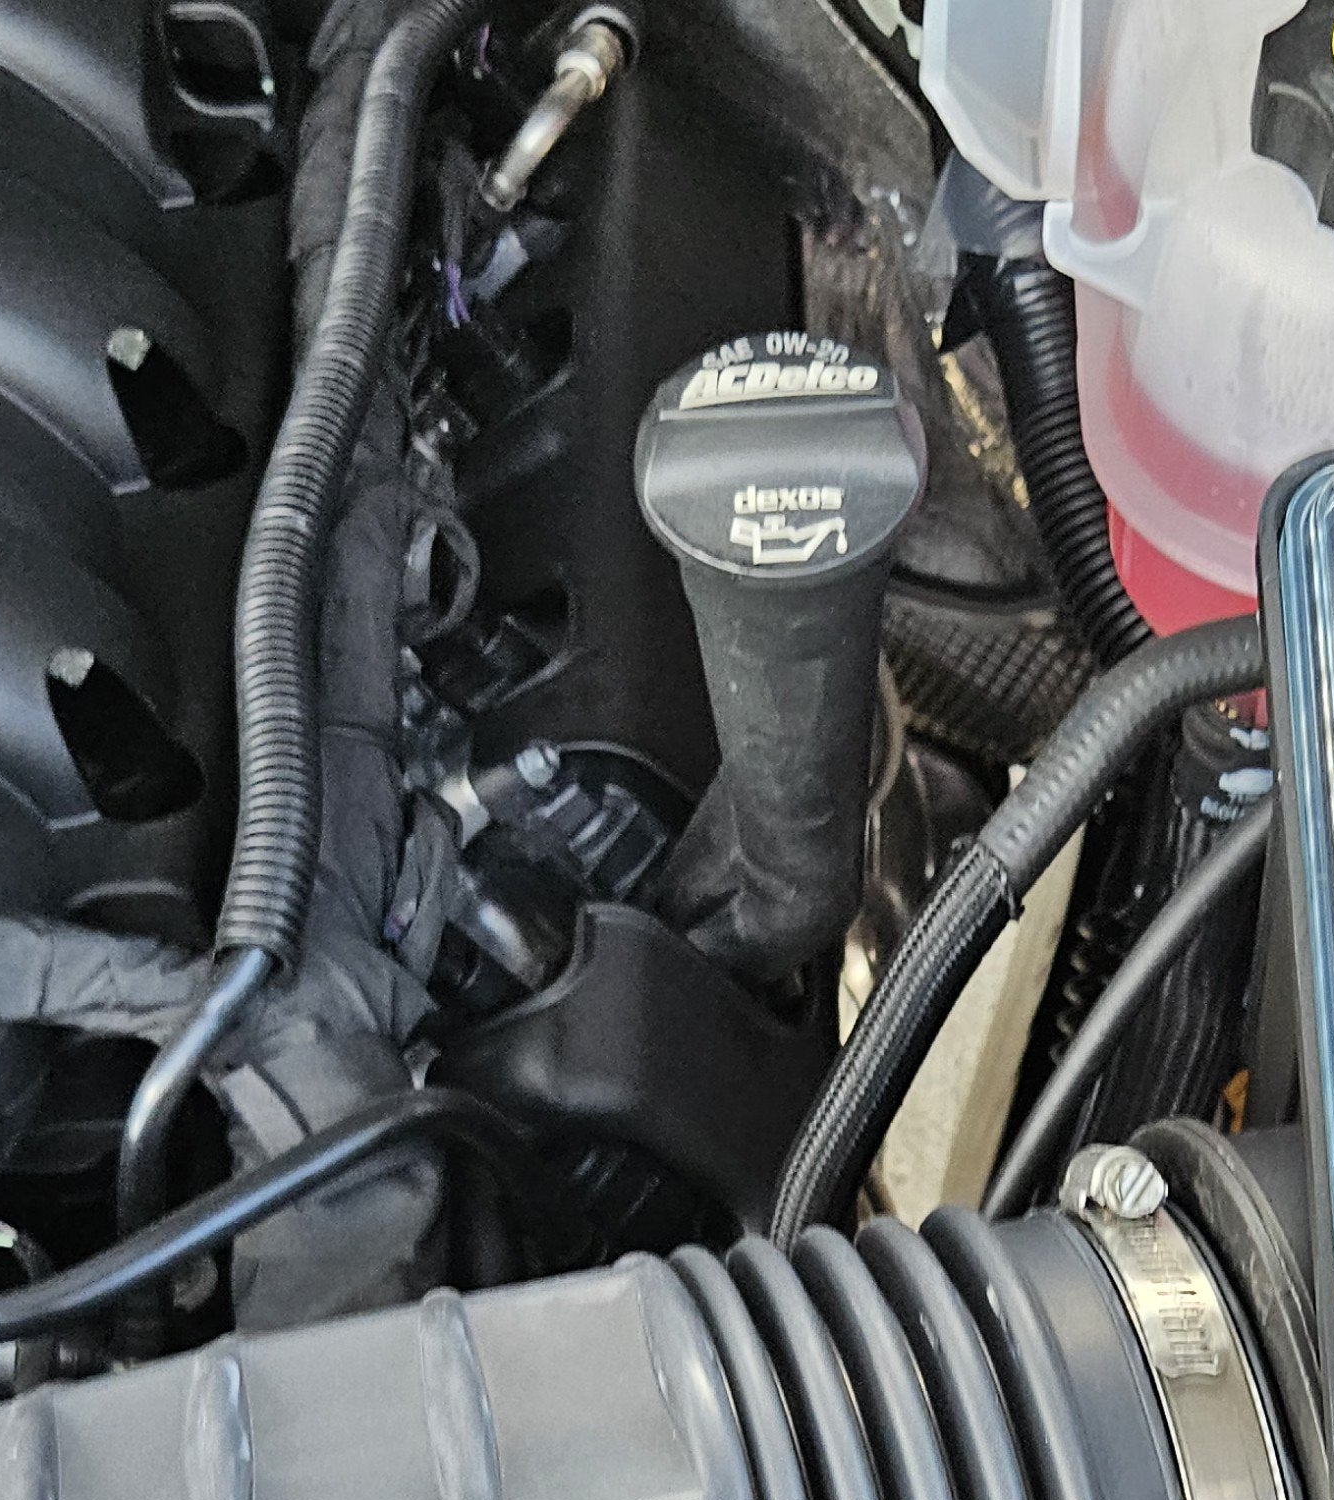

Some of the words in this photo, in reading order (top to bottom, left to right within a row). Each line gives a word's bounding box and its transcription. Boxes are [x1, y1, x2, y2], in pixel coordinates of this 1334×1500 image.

[702, 336, 754, 370] SAE
[679, 360, 878, 411] ACDelco
[734, 484, 845, 514] dexos
